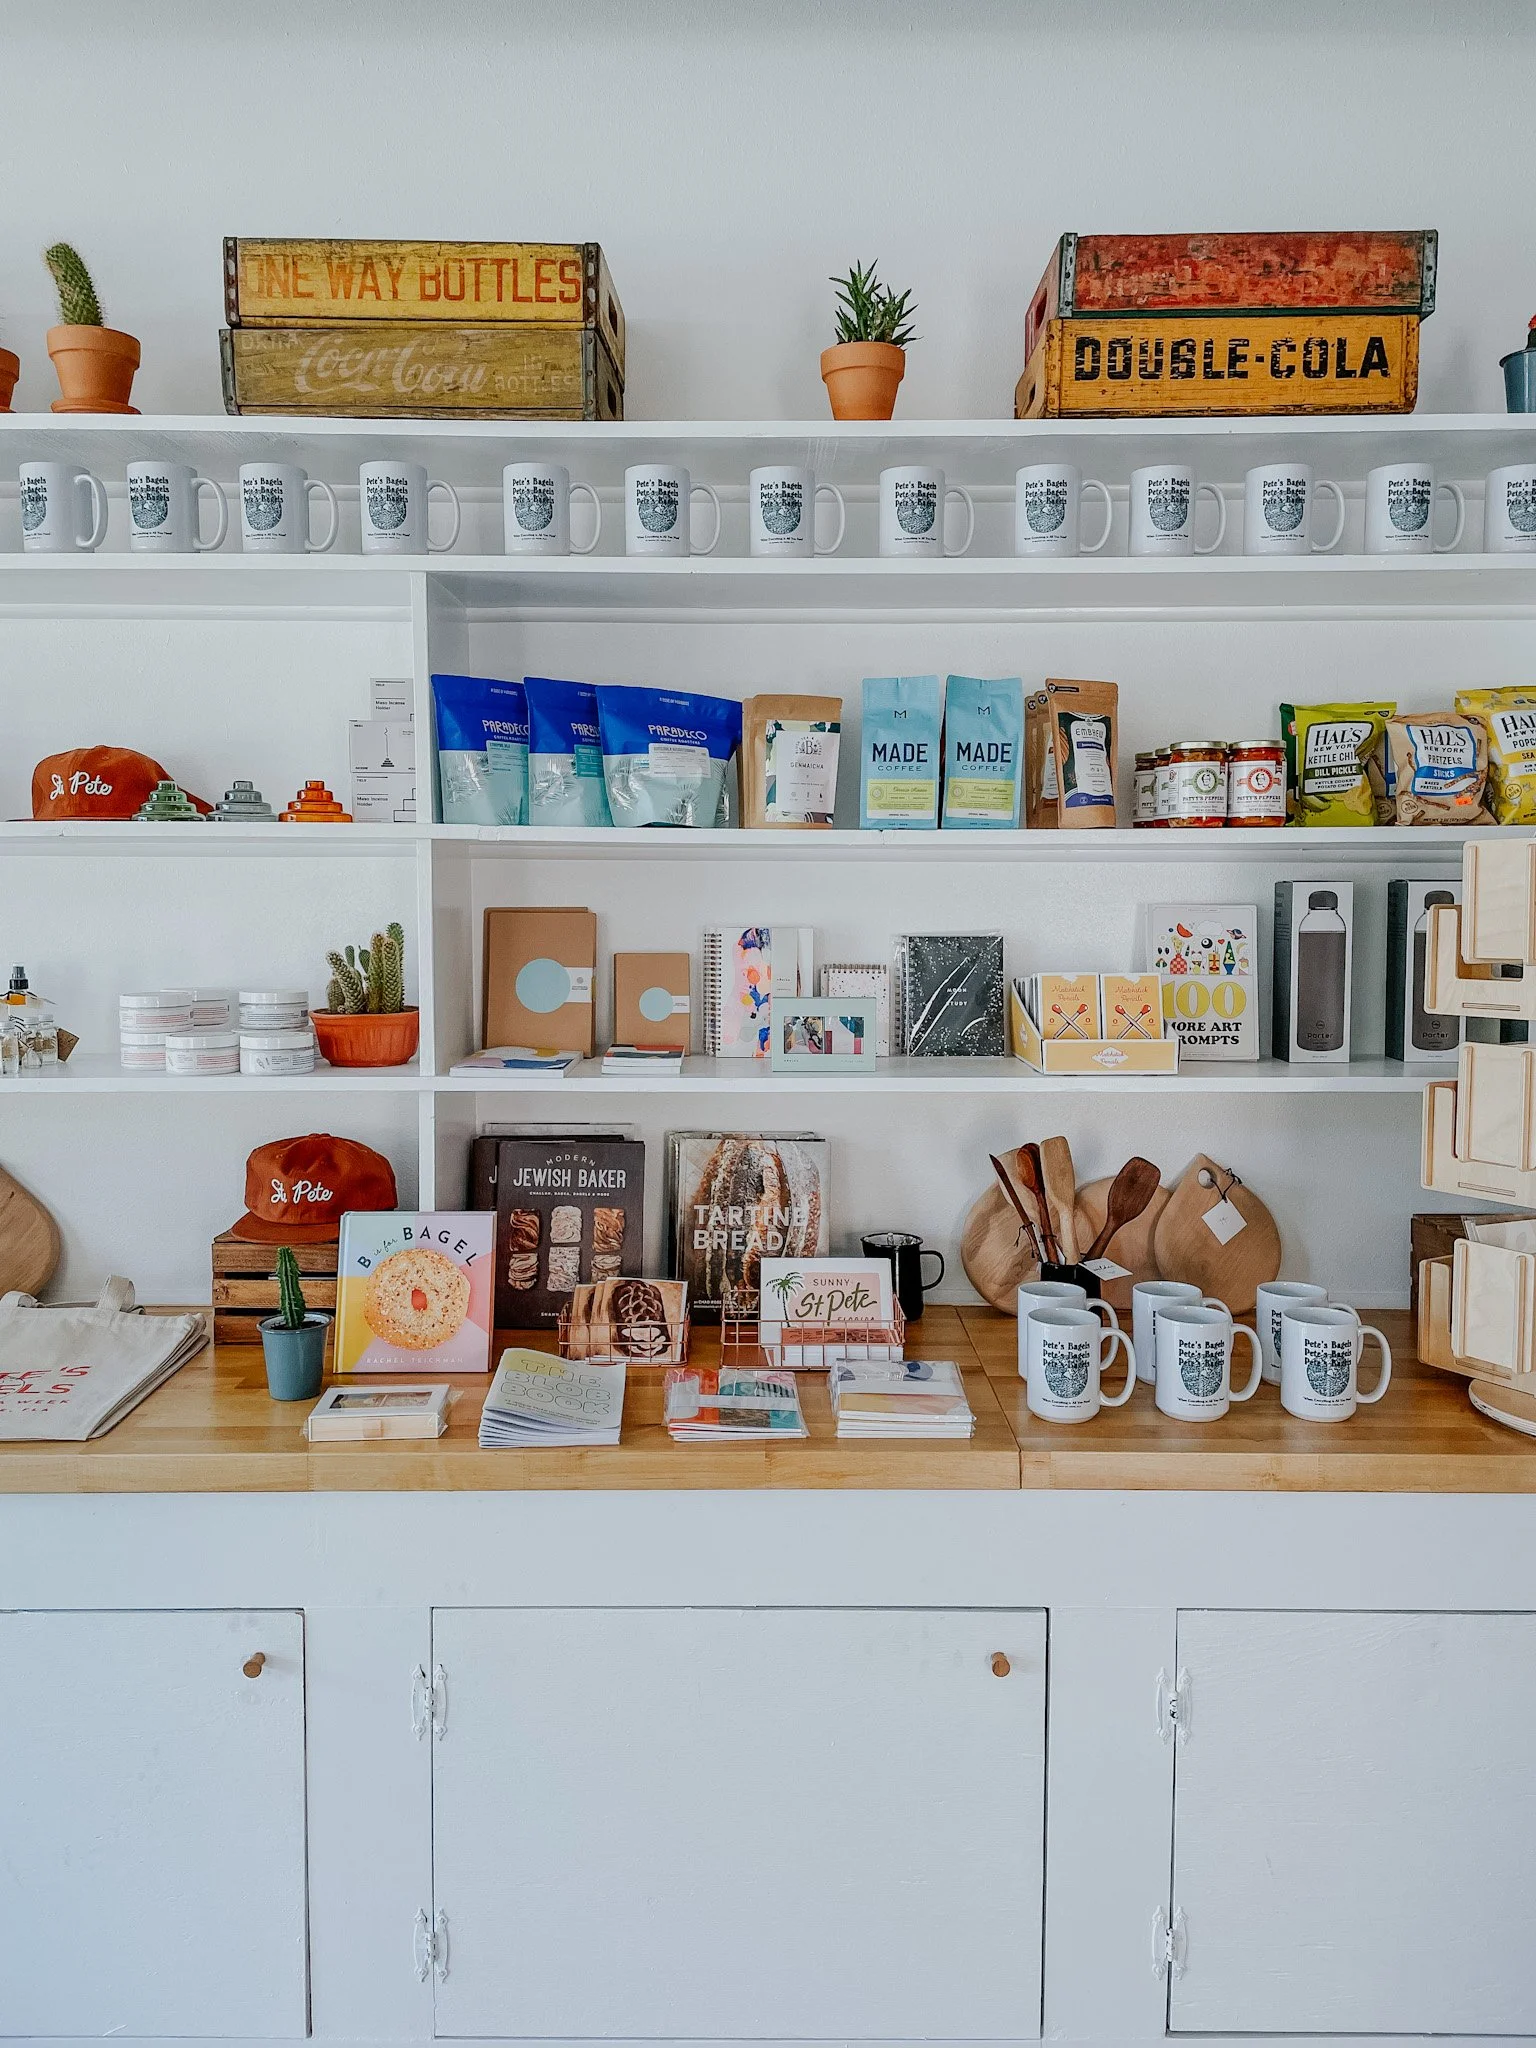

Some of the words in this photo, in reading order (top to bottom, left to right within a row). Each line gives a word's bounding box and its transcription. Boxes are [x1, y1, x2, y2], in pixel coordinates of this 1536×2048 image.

[325, 256, 406, 299] WAY
[419, 258, 581, 303] BOTTLES
[243, 477, 258, 486] Pete's
[366, 477, 383, 486] Pete's
[512, 478, 530, 486] Pete's
[636, 479, 655, 488] Pete's
[760, 482, 779, 491] Pete's
[895, 481, 915, 490] Pete's
[1025, 480, 1044, 490] Pete's
[1148, 479, 1169, 487] Pete's
[1263, 479, 1284, 488] Pete's
[1388, 479, 1410, 488] Pete's
[1507, 480, 1529, 489] Pete's
[1501, 713, 1536, 733] HAL
[648, 725, 707, 740] PARADECO
[1315, 728, 1362, 746] HAL'S
[1420, 729, 1467, 746] HAL'S
[1506, 730, 1527, 739] NEW
[1314, 744, 1332, 752] NEW
[1512, 738, 1536, 749] POPC
[872, 743, 928, 763] MADE
[956, 742, 1012, 763] MADE
[1308, 753, 1337, 765] KETTLE
[1428, 754, 1463, 765] PRETZELS
[961, 764, 1006, 772] COFFEE
[1314, 767, 1330, 777] DILL
[1331, 765, 1357, 775] PICKLE
[1433, 769, 1455, 778] STICKS
[68, 770, 113, 796] Pete
[1162, 980, 1247, 1019] 100
[1210, 1021, 1242, 1032] ART
[1179, 1035, 1240, 1045] ROMPTS
[546, 1154, 596, 1167] MODERN
[513, 1168, 571, 1188] JEWISH
[578, 1169, 627, 1188] BAKER
[292, 1179, 333, 1204] Pete
[693, 1204, 808, 1227] TARTINE
[693, 1230, 785, 1250] BREAD
[357, 1255, 372, 1269] B
[383, 1238, 399, 1253] for
[402, 1225, 478, 1267] BAGEL
[813, 1278, 850, 1287] SUNNY
[795, 1292, 824, 1318] St.
[826, 1282, 878, 1326] Pete
[1043, 1340, 1065, 1350] Pete's
[1068, 1341, 1090, 1351] Bagels
[1178, 1339, 1201, 1349] Pete's
[1204, 1340, 1225, 1350] Bagels
[1304, 1339, 1328, 1349] Pete's
[1331, 1339, 1352, 1349] Bagels
[1043, 1349, 1065, 1358] Pete's
[1178, 1349, 1201, 1358] Pete's
[1304, 1348, 1328, 1358] Pete's
[521, 1359, 601, 1387] THE
[0, 1383, 75, 1395] ELS
[505, 1370, 611, 1401] BLOB
[500, 1382, 610, 1414] BOOK
